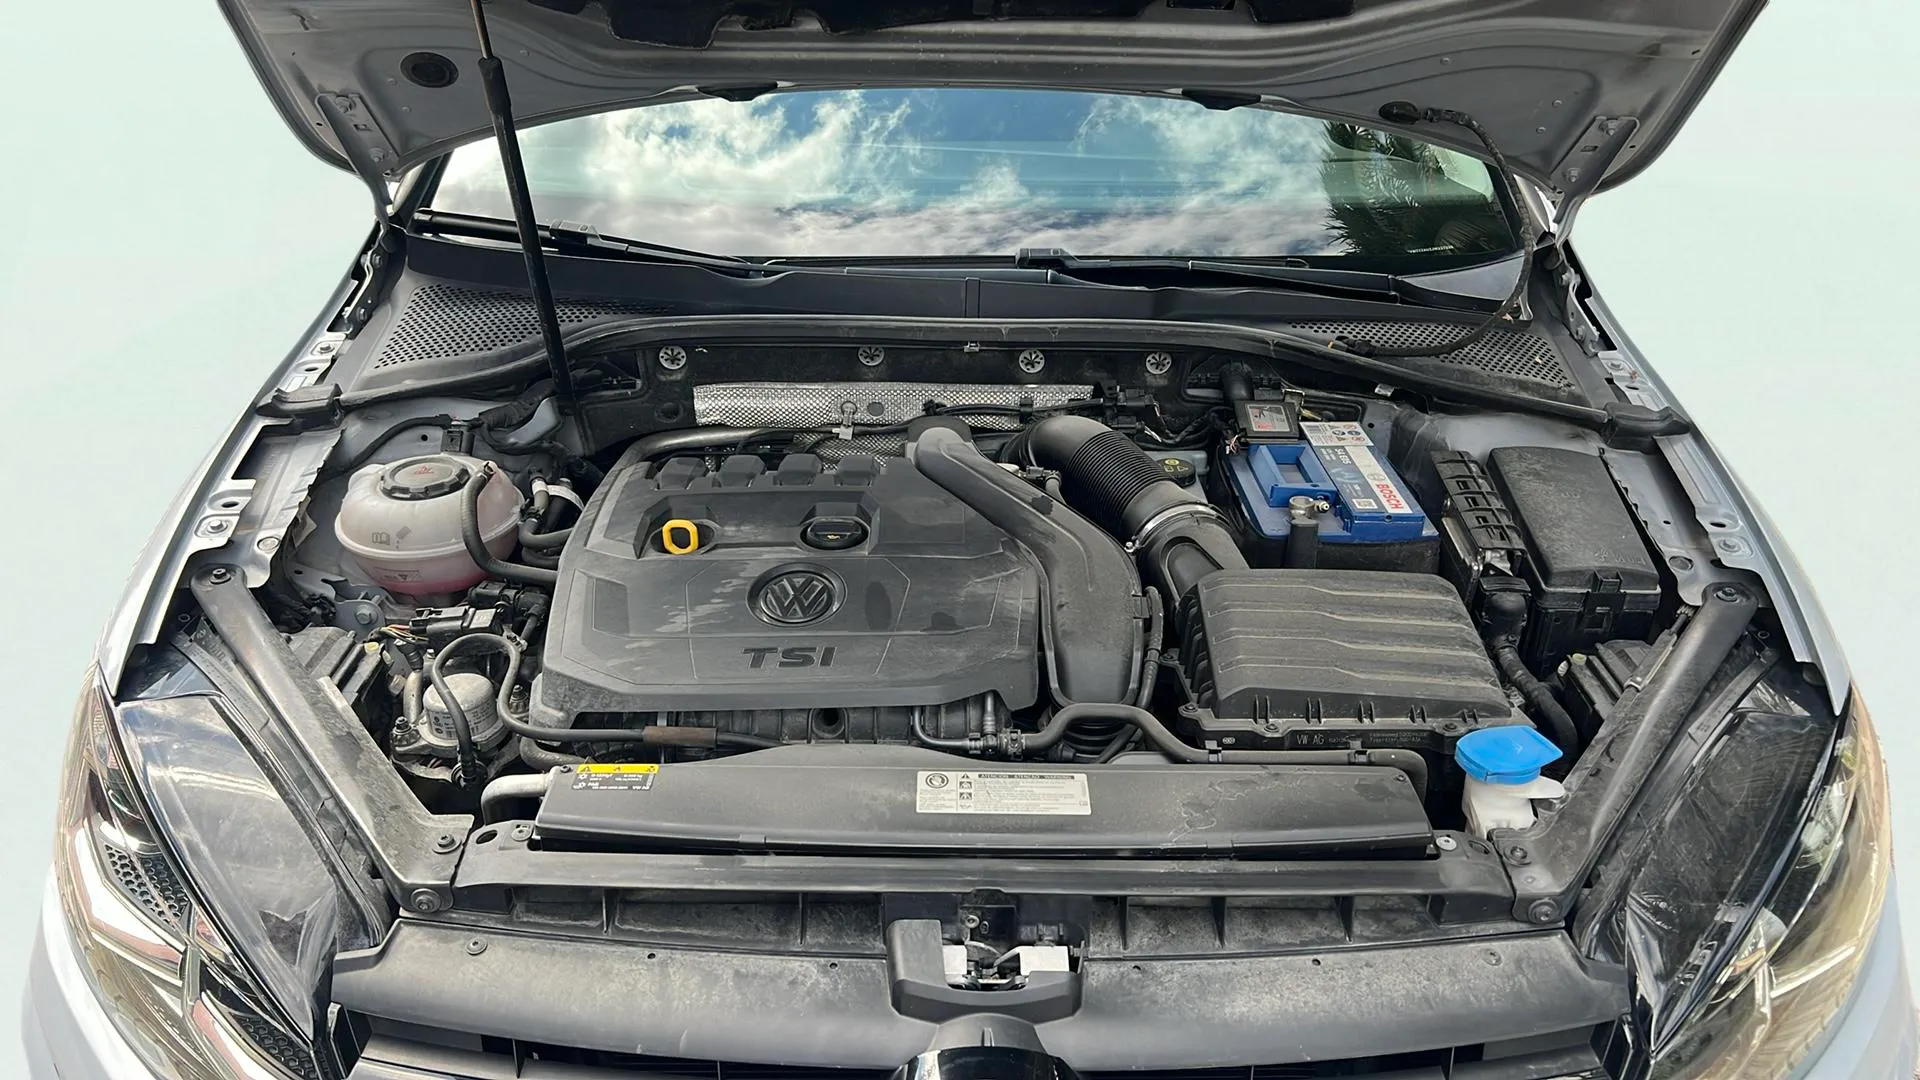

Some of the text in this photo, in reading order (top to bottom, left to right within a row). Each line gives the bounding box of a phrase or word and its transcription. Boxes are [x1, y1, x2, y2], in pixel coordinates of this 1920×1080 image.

[1376, 483, 1404, 509] BOSCH
[764, 574, 832, 620] VW
[743, 647, 837, 669] TSI
[1296, 734, 1309, 745] VW
[1312, 734, 1325, 745] AG
